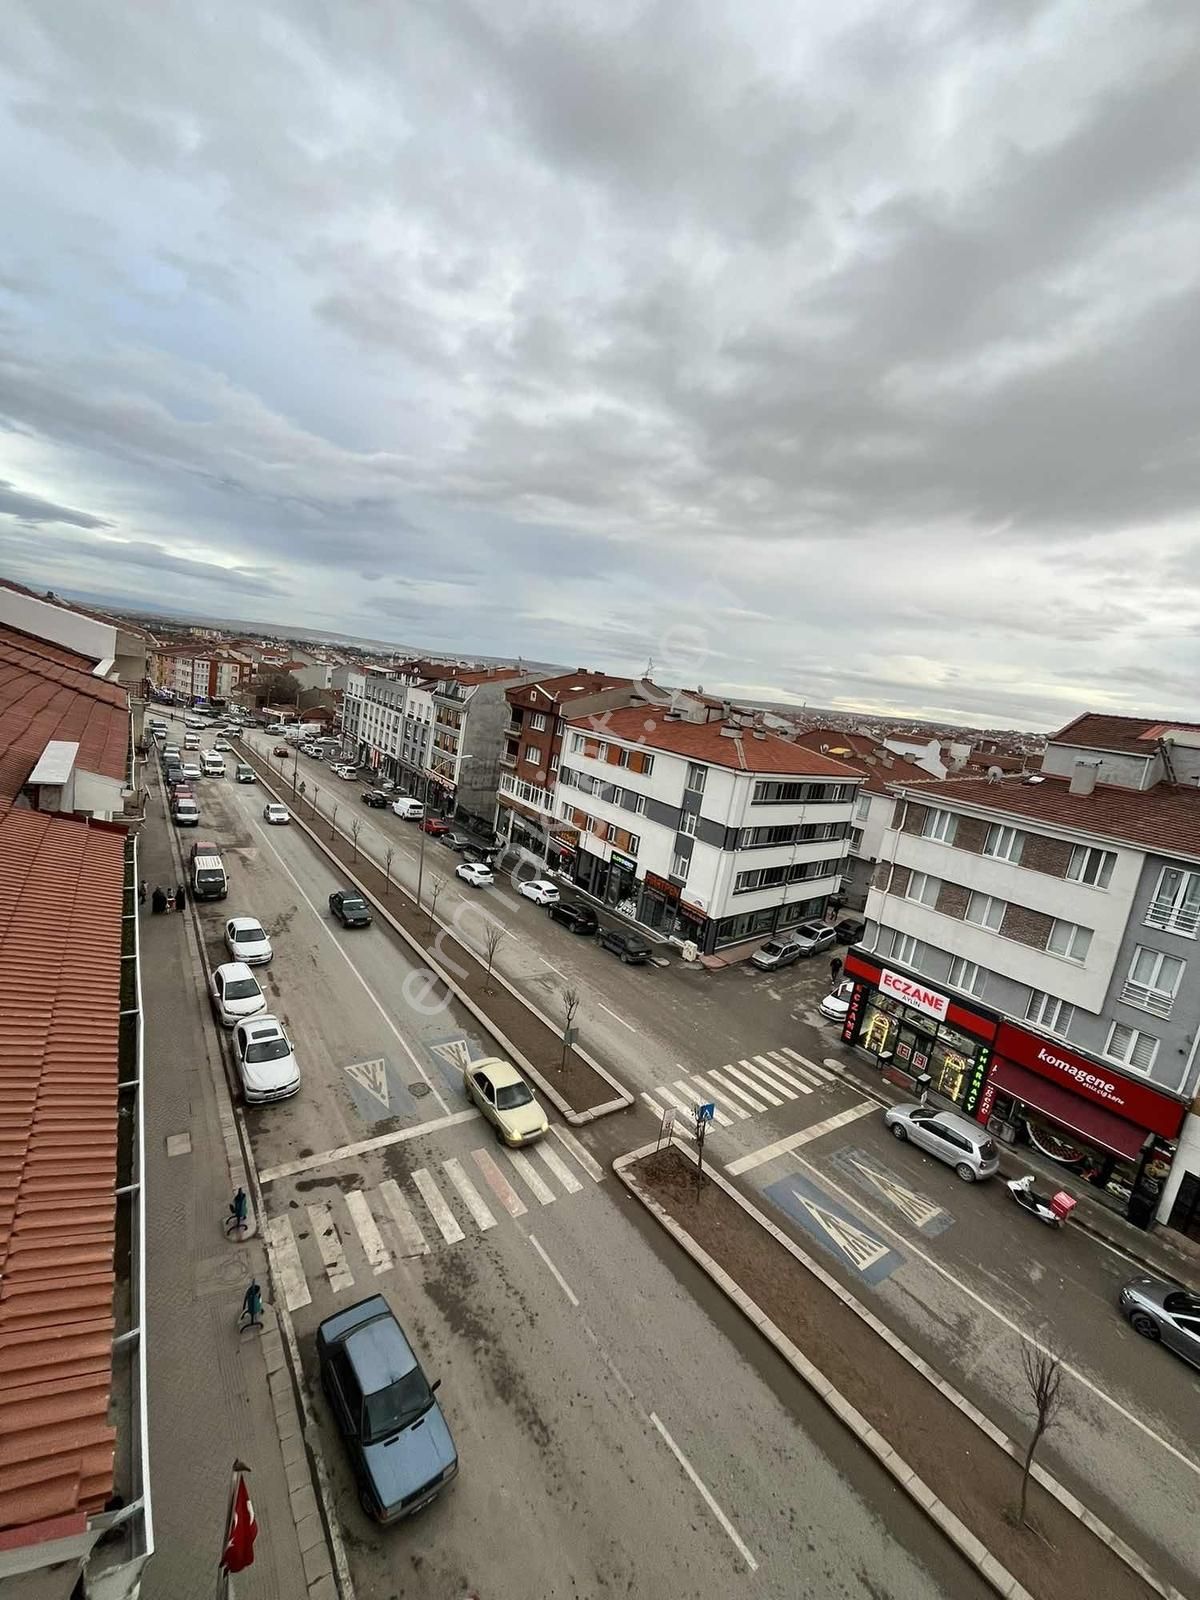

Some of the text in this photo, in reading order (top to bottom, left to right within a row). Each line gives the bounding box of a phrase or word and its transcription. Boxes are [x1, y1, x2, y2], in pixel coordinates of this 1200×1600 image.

[844, 983, 863, 1039] ECZANE
[884, 974, 944, 1011] ECZANE
[967, 1048, 989, 1111] PHARMACY
[1037, 1048, 1115, 1092] komagene
